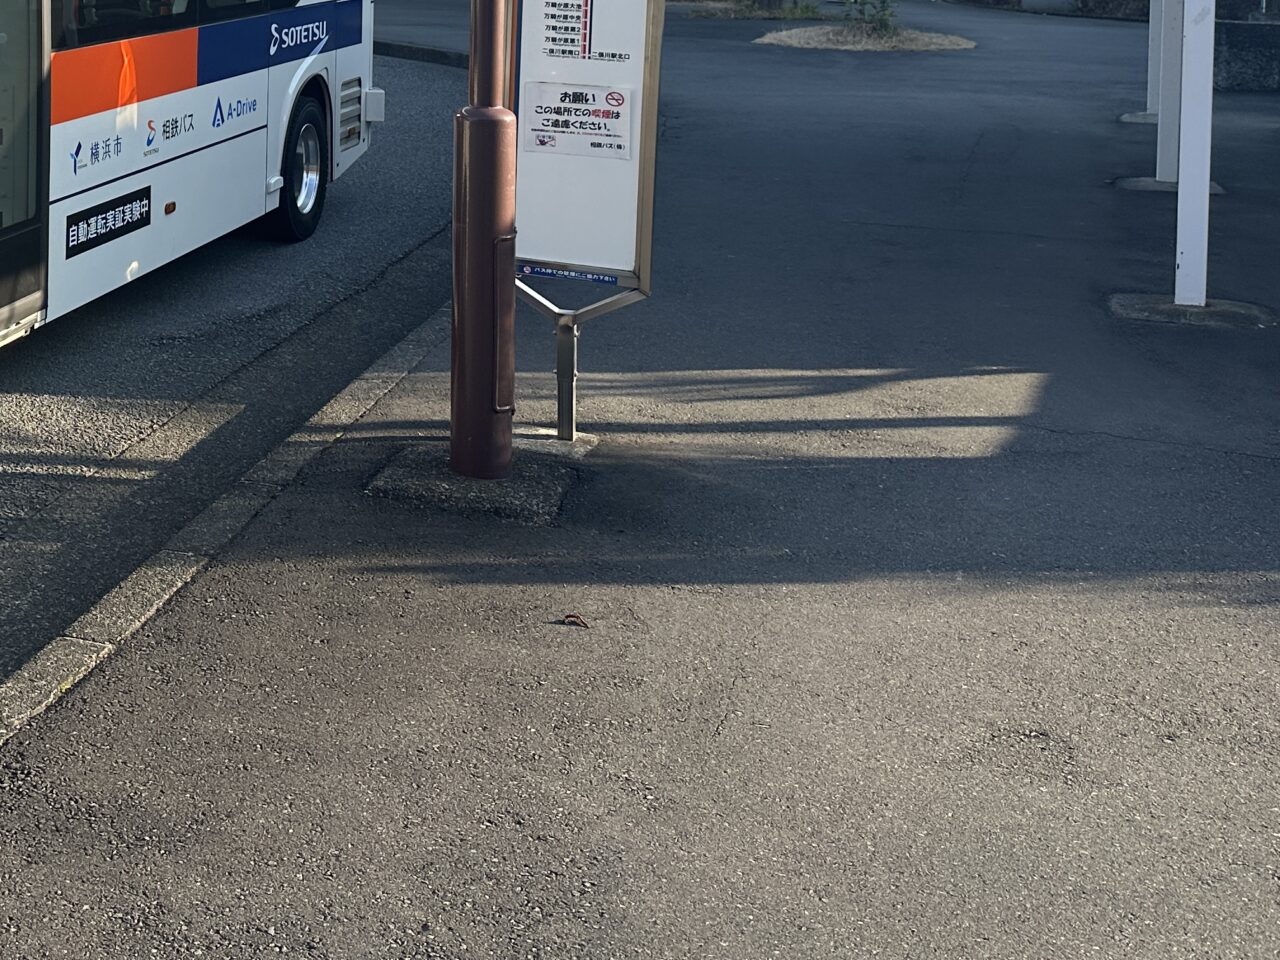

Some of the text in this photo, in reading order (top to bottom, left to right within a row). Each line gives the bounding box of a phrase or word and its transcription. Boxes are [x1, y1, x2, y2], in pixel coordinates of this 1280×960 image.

[281, 20, 327, 48] SOTETSU
[227, 98, 257, 120] A-Drive
[560, 91, 596, 103] お願い
[534, 105, 621, 119] この場所での喫煙は
[162, 113, 195, 141] 相鉄バス
[90, 135, 122, 165] 横浜市
[69, 197, 149, 247] 自動運転実証実験中
